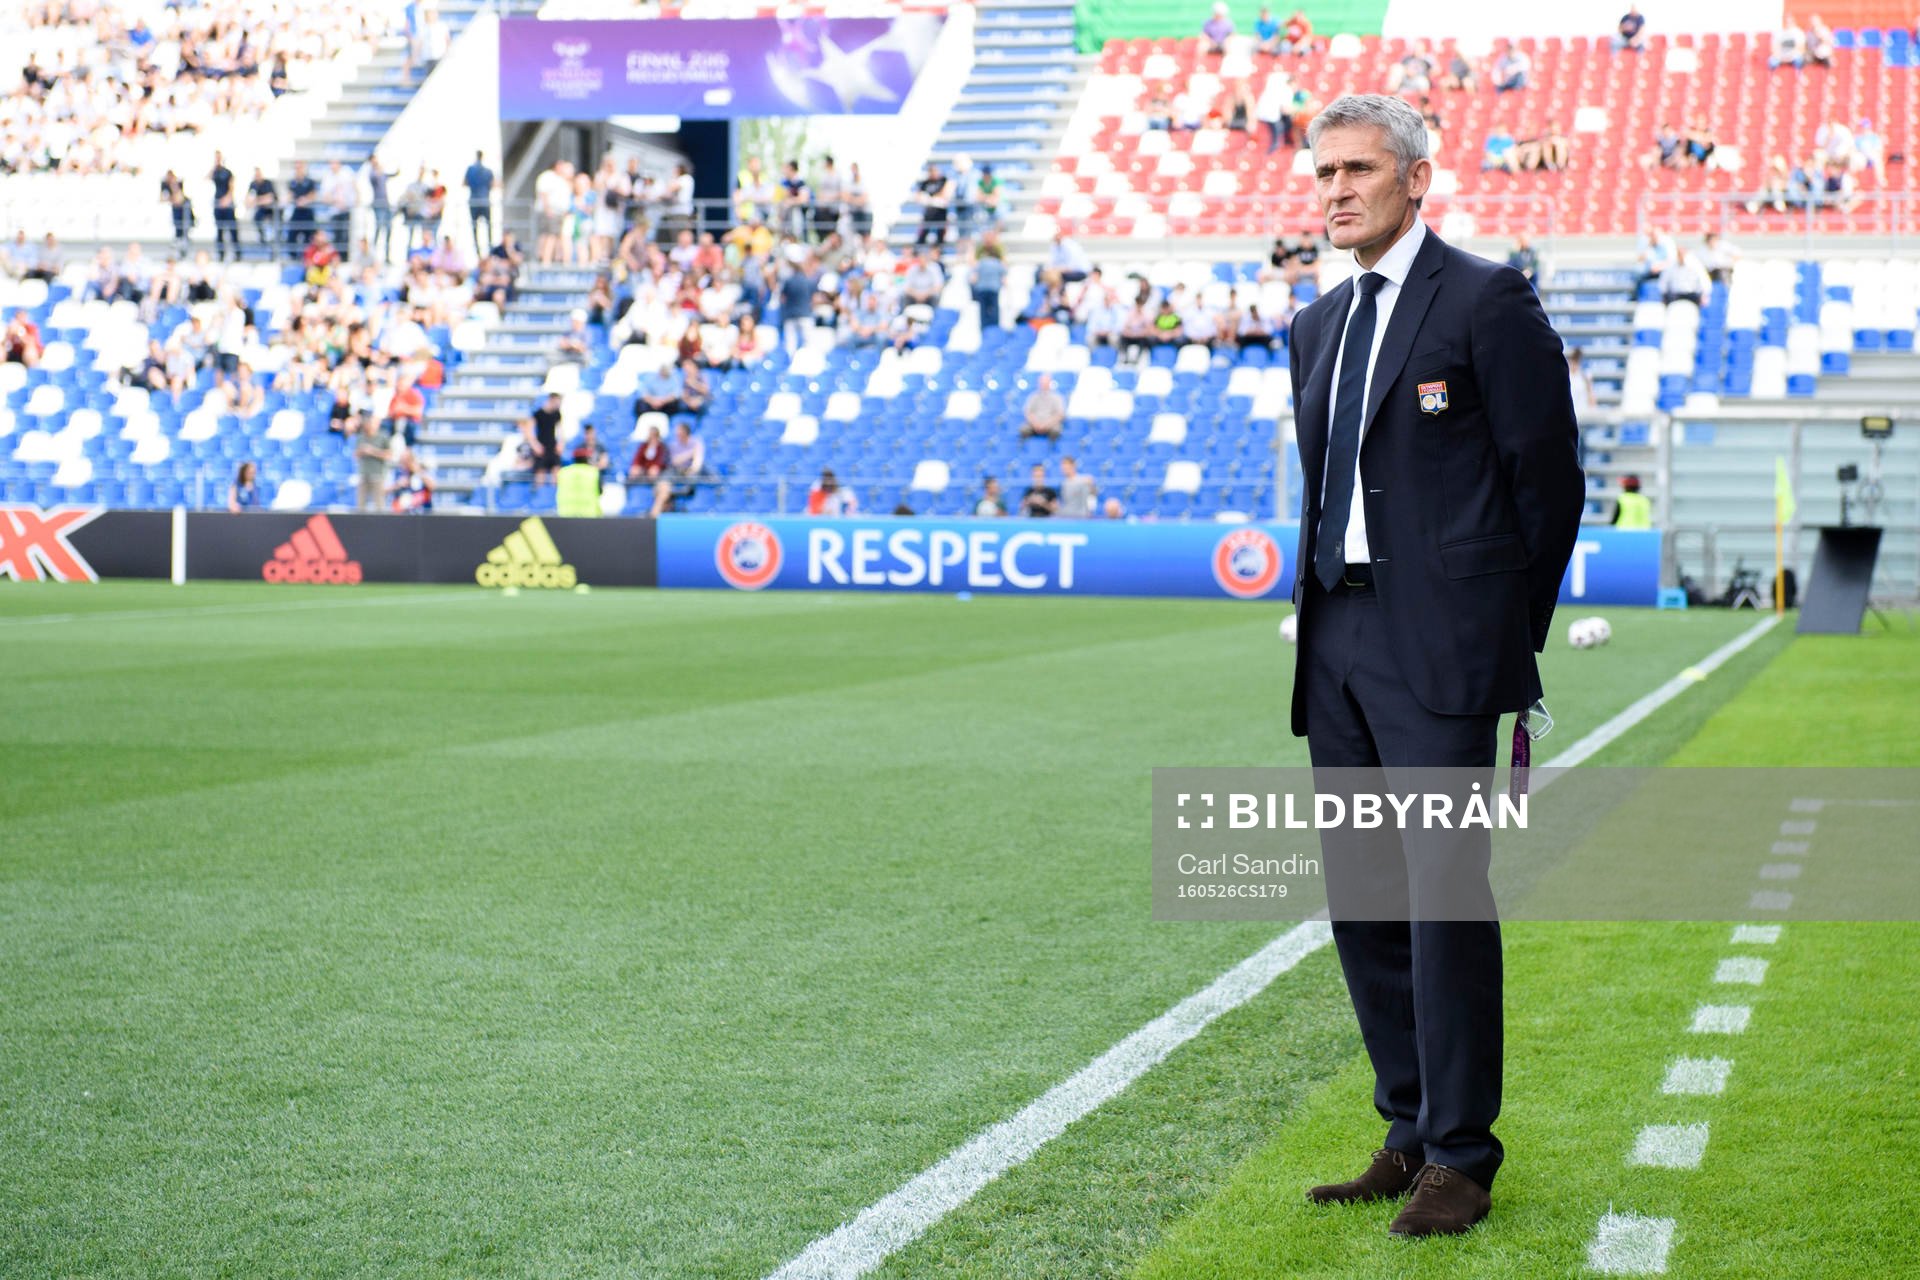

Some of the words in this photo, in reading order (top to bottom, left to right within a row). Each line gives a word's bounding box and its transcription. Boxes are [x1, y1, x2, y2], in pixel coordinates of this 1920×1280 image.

[262, 559, 362, 585] adidas
[808, 529, 1087, 588] RESPECT
[475, 562, 577, 589] adidas
